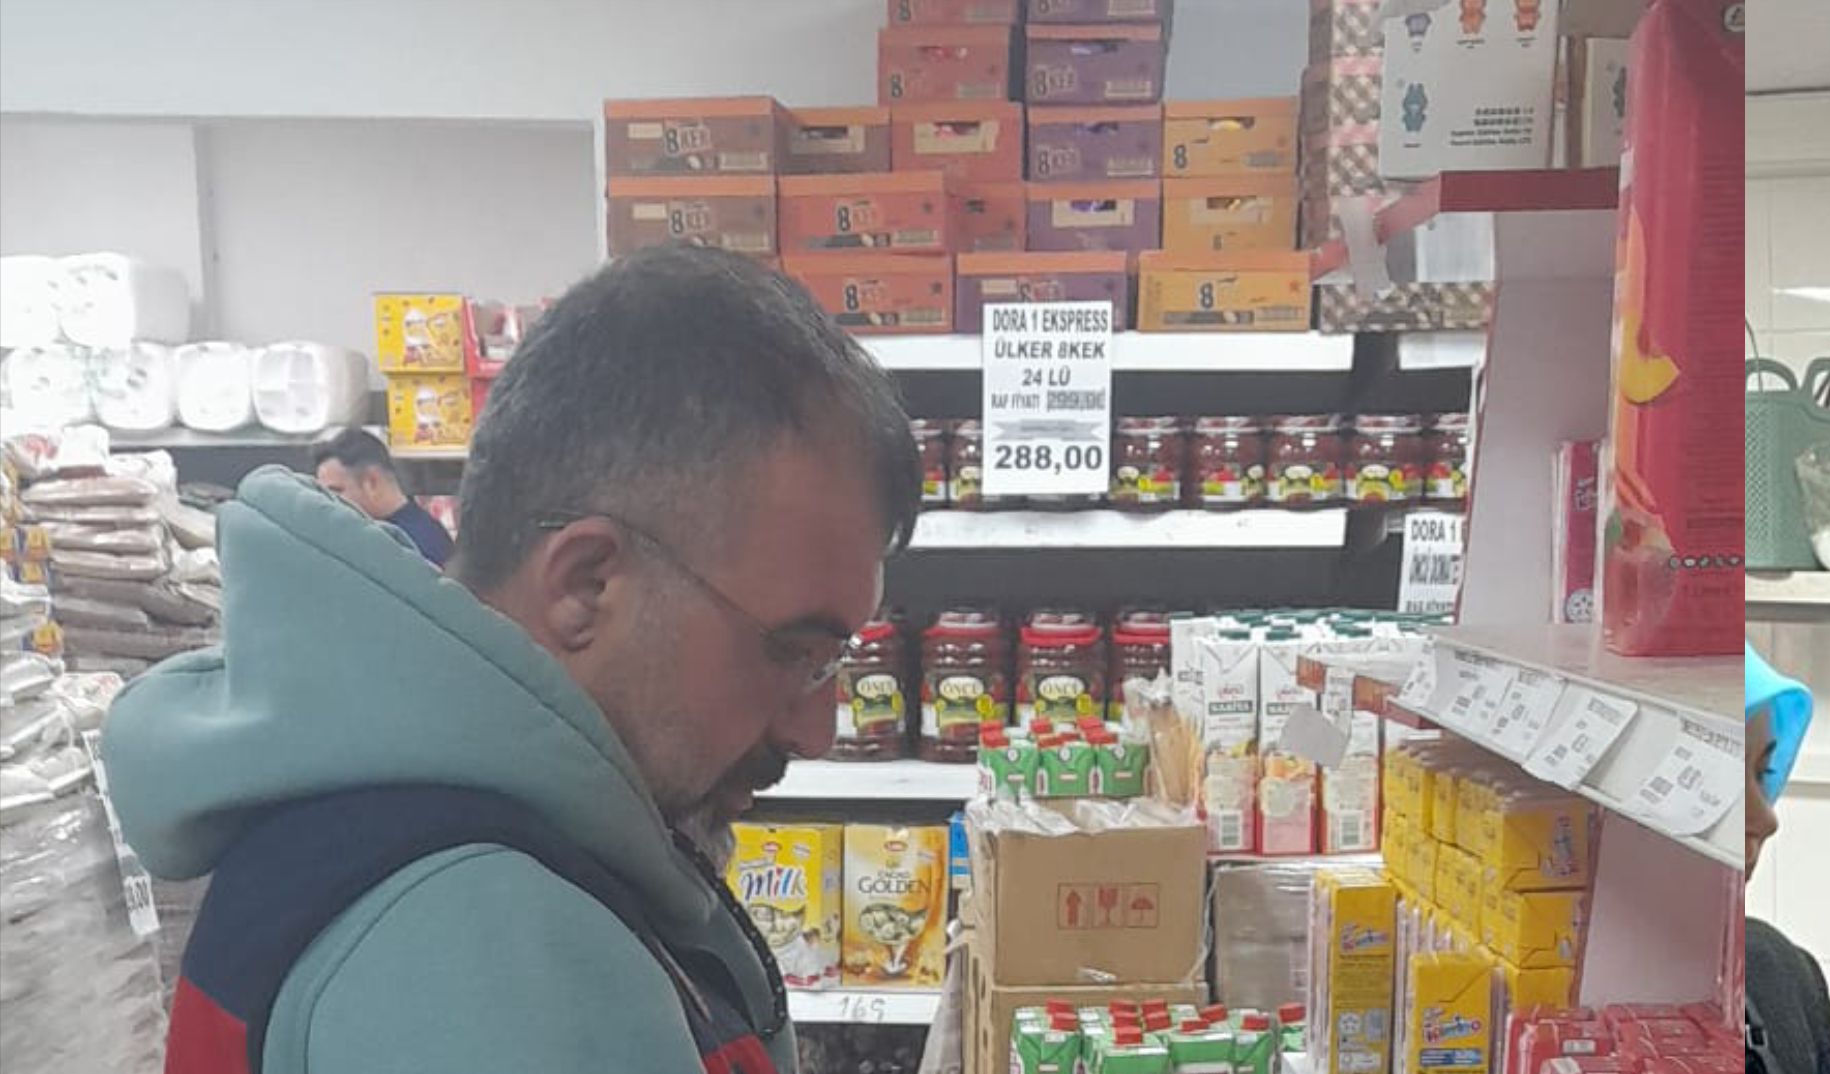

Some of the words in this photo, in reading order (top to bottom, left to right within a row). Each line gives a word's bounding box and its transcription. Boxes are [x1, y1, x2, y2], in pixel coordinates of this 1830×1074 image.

[993, 308, 1027, 332] DORA
[1032, 309, 1038, 332] 1
[1042, 308, 1108, 332] EKSPRESS
[994, 337, 1052, 359] ÜLKER
[1057, 340, 1106, 359] 8KEK
[1022, 368, 1042, 386] 24
[1049, 365, 1071, 386] LÜ
[994, 445, 1102, 475] 288,00
[1411, 518, 1446, 542] DORA
[1450, 519, 1456, 542] 1
[858, 875, 931, 894] GOLDEN
